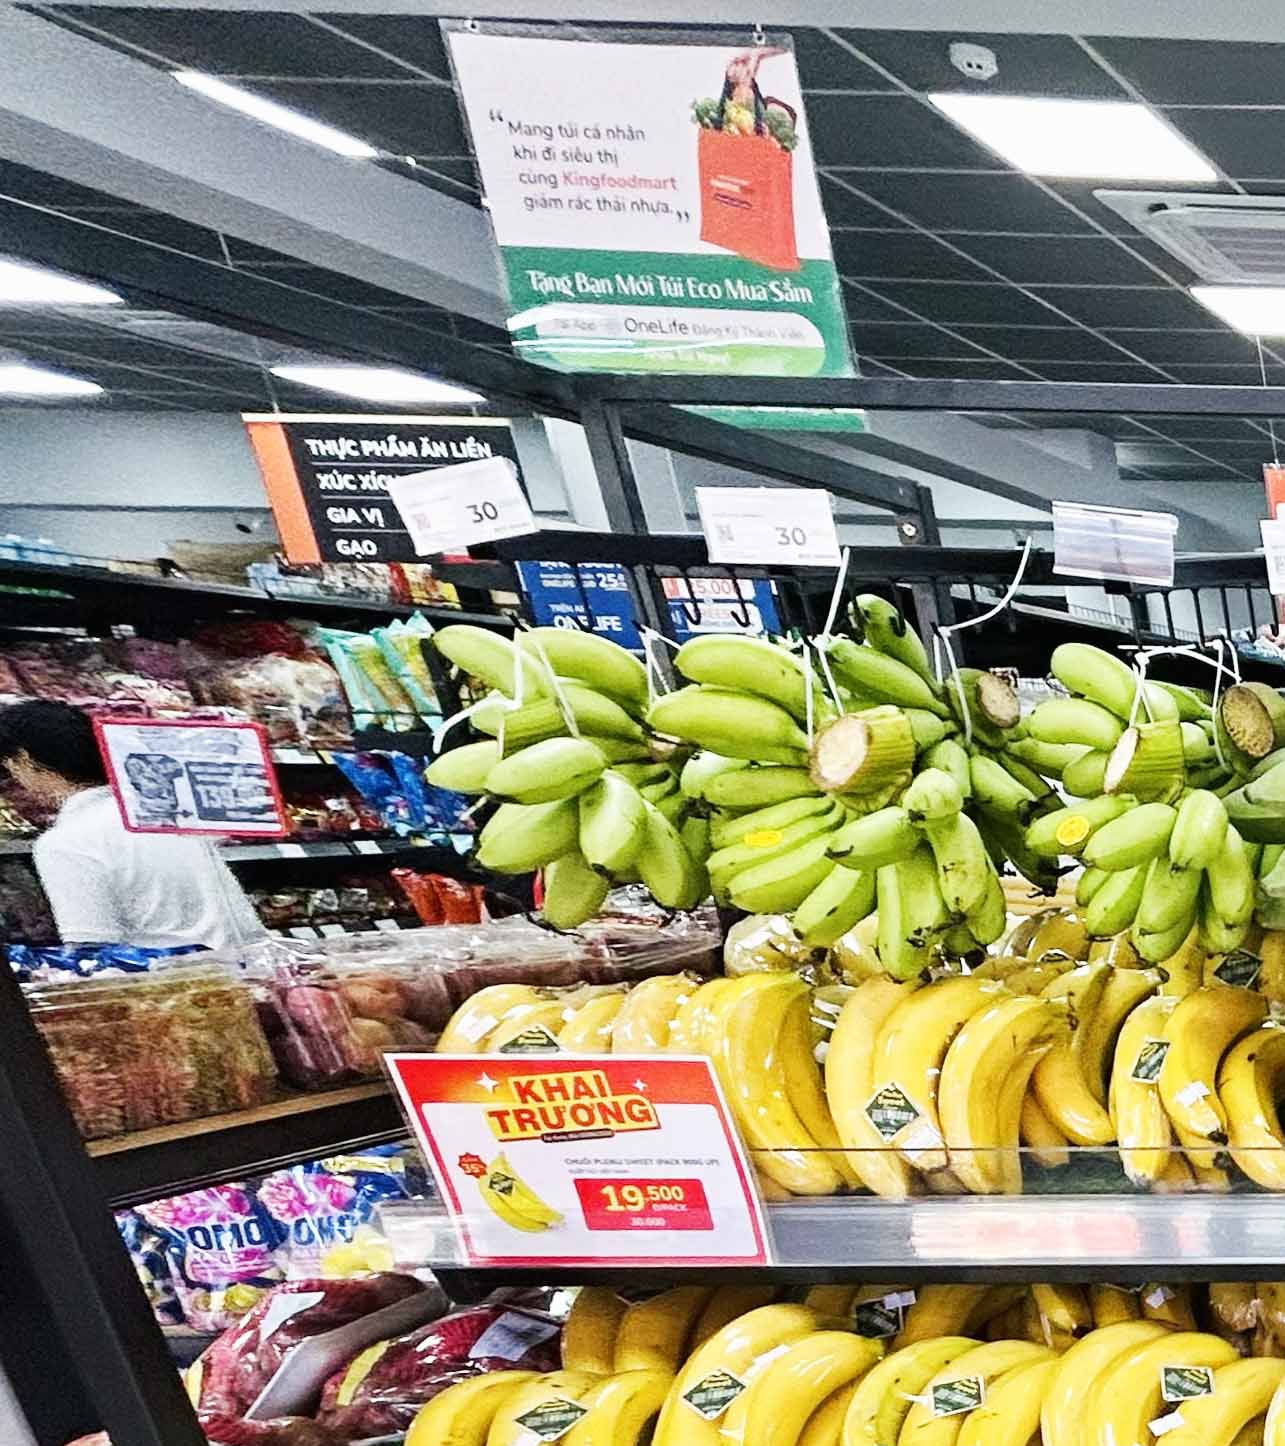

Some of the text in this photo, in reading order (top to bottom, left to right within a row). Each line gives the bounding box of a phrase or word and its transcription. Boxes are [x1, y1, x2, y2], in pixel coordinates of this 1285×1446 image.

[562, 170, 677, 190] Kingfoodmart
[687, 278, 721, 299] Eco
[724, 279, 767, 301] Mua
[624, 317, 689, 335] OneLife
[304, 438, 360, 460] THỰC
[326, 507, 385, 527] GIA VỊ
[465, 501, 498, 523] 30
[775, 527, 807, 546] 30
[335, 539, 378, 559] GẠO
[513, 1073, 608, 1103] KHAI
[487, 1099, 650, 1134] TRƯƠNG
[190, 1219, 264, 1250] OMO
